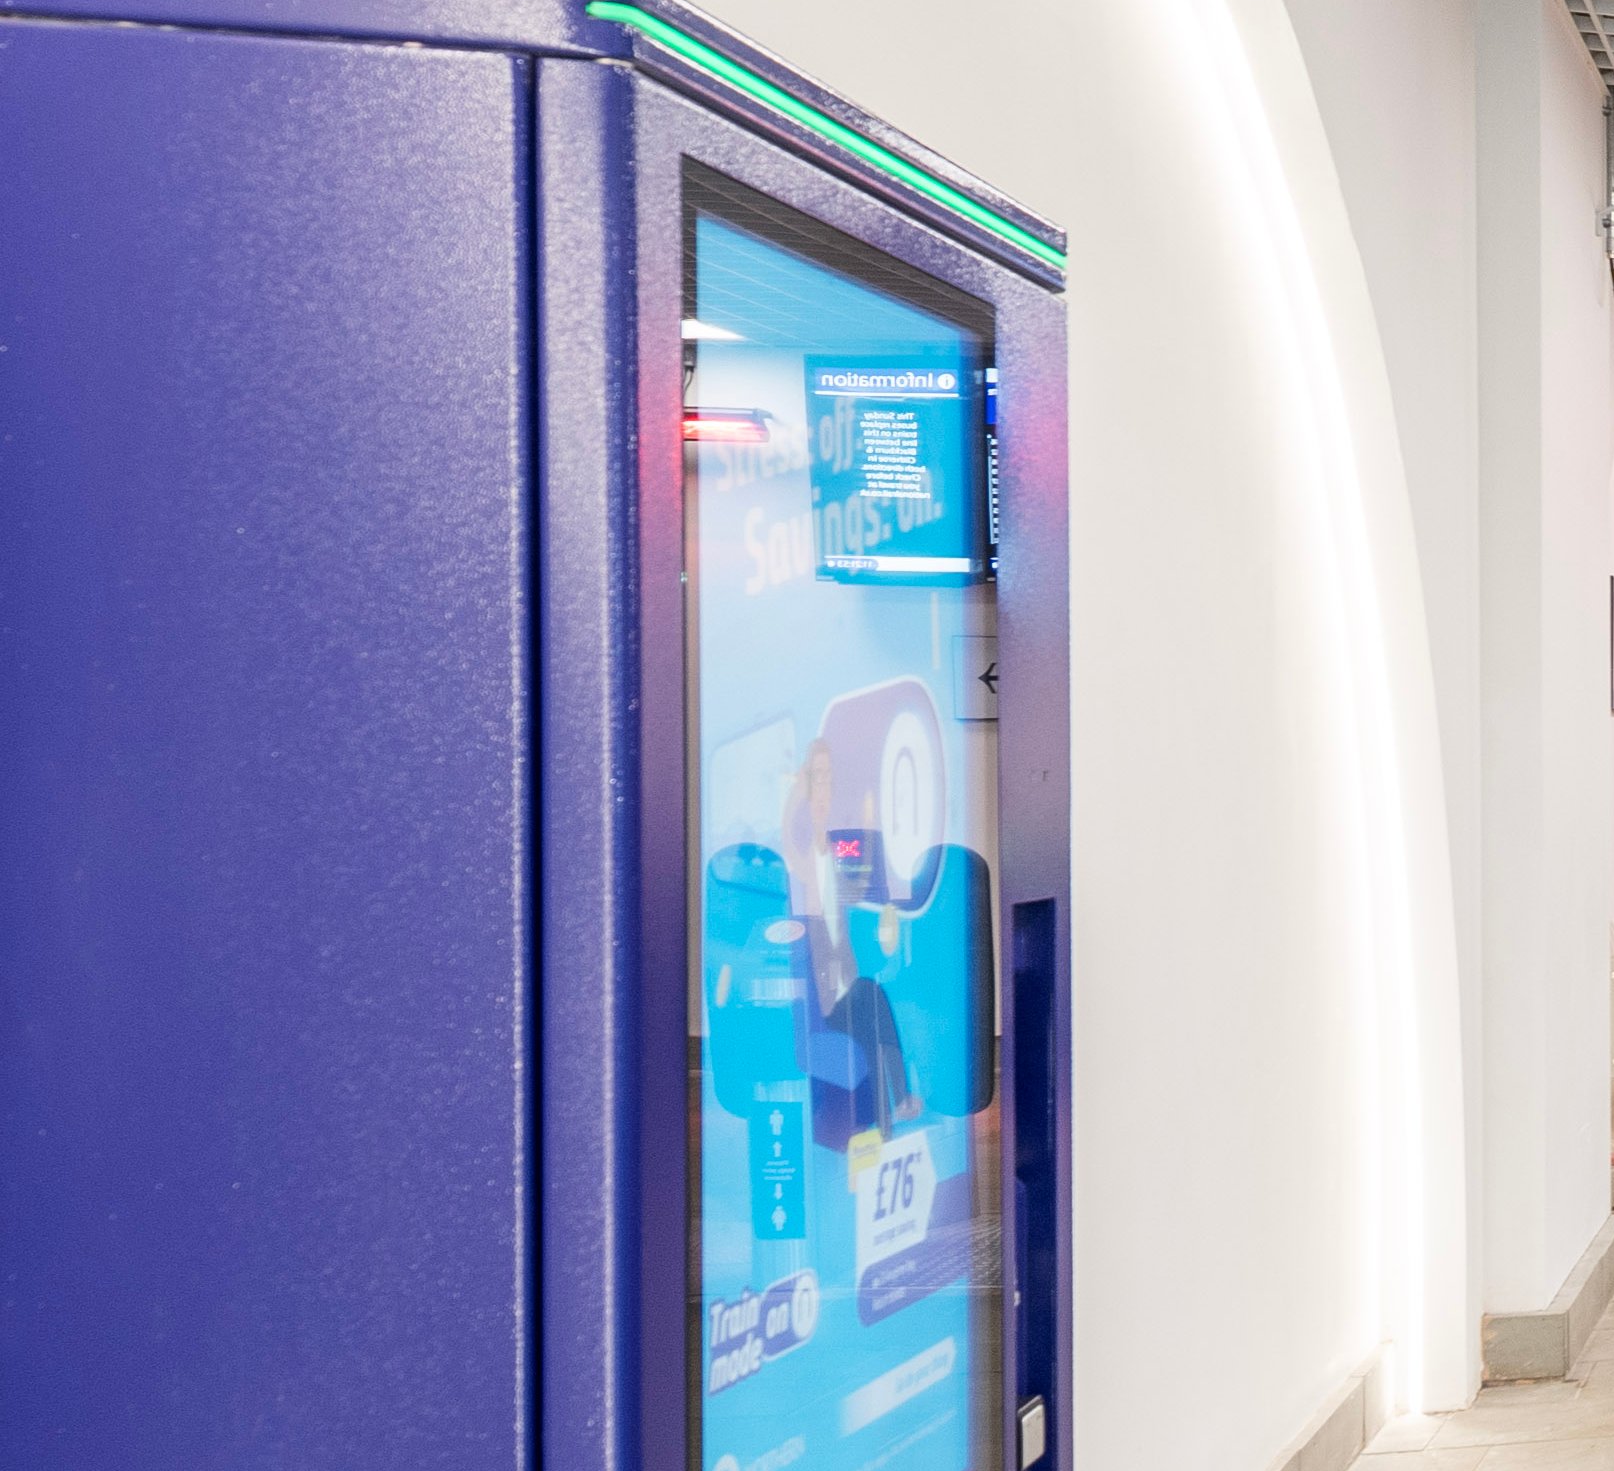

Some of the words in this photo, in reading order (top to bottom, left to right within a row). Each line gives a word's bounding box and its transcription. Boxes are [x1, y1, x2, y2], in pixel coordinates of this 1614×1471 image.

[709, 1285, 759, 1347] Train
[766, 1301, 790, 1339] on
[709, 1332, 763, 1395] mode
